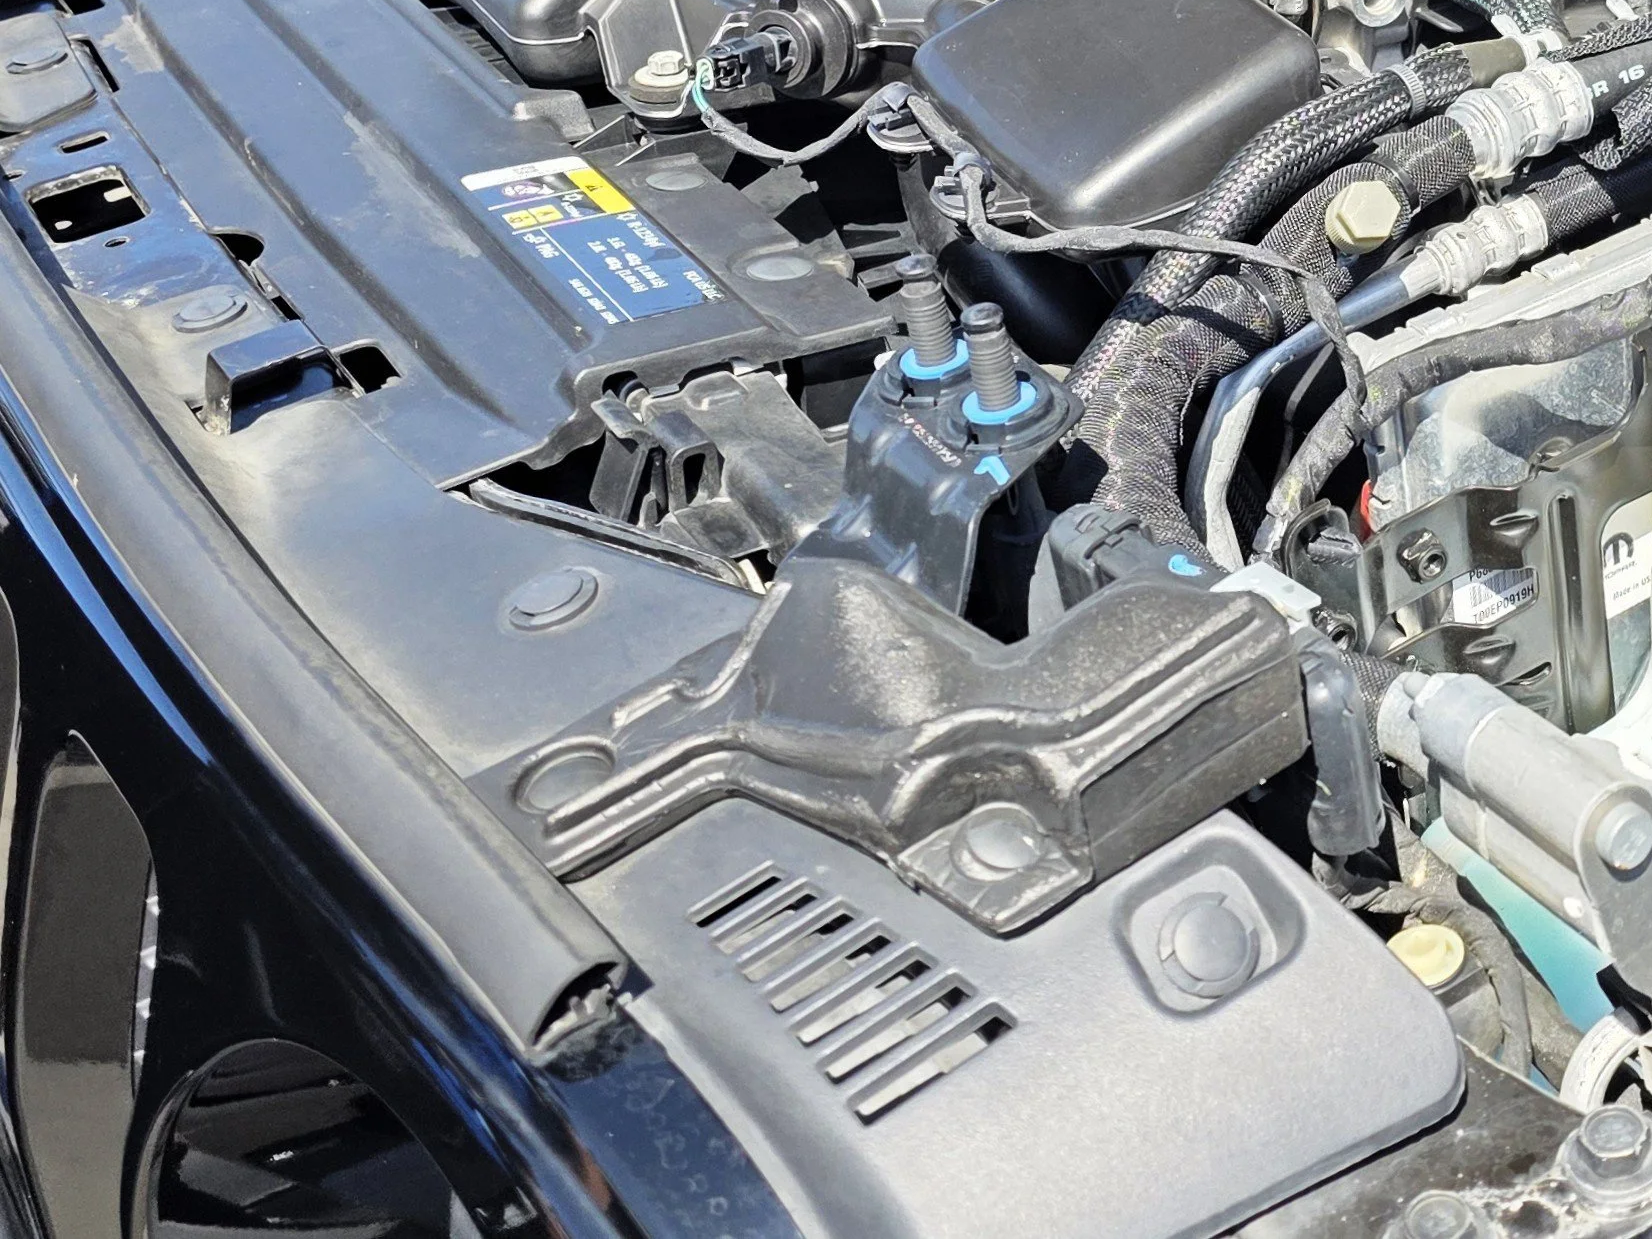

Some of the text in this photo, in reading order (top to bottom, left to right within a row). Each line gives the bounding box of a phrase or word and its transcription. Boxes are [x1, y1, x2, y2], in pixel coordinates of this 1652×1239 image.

[1618, 64, 1646, 84] 16
[1613, 587, 1631, 601] Made
[1632, 581, 1640, 590] in
